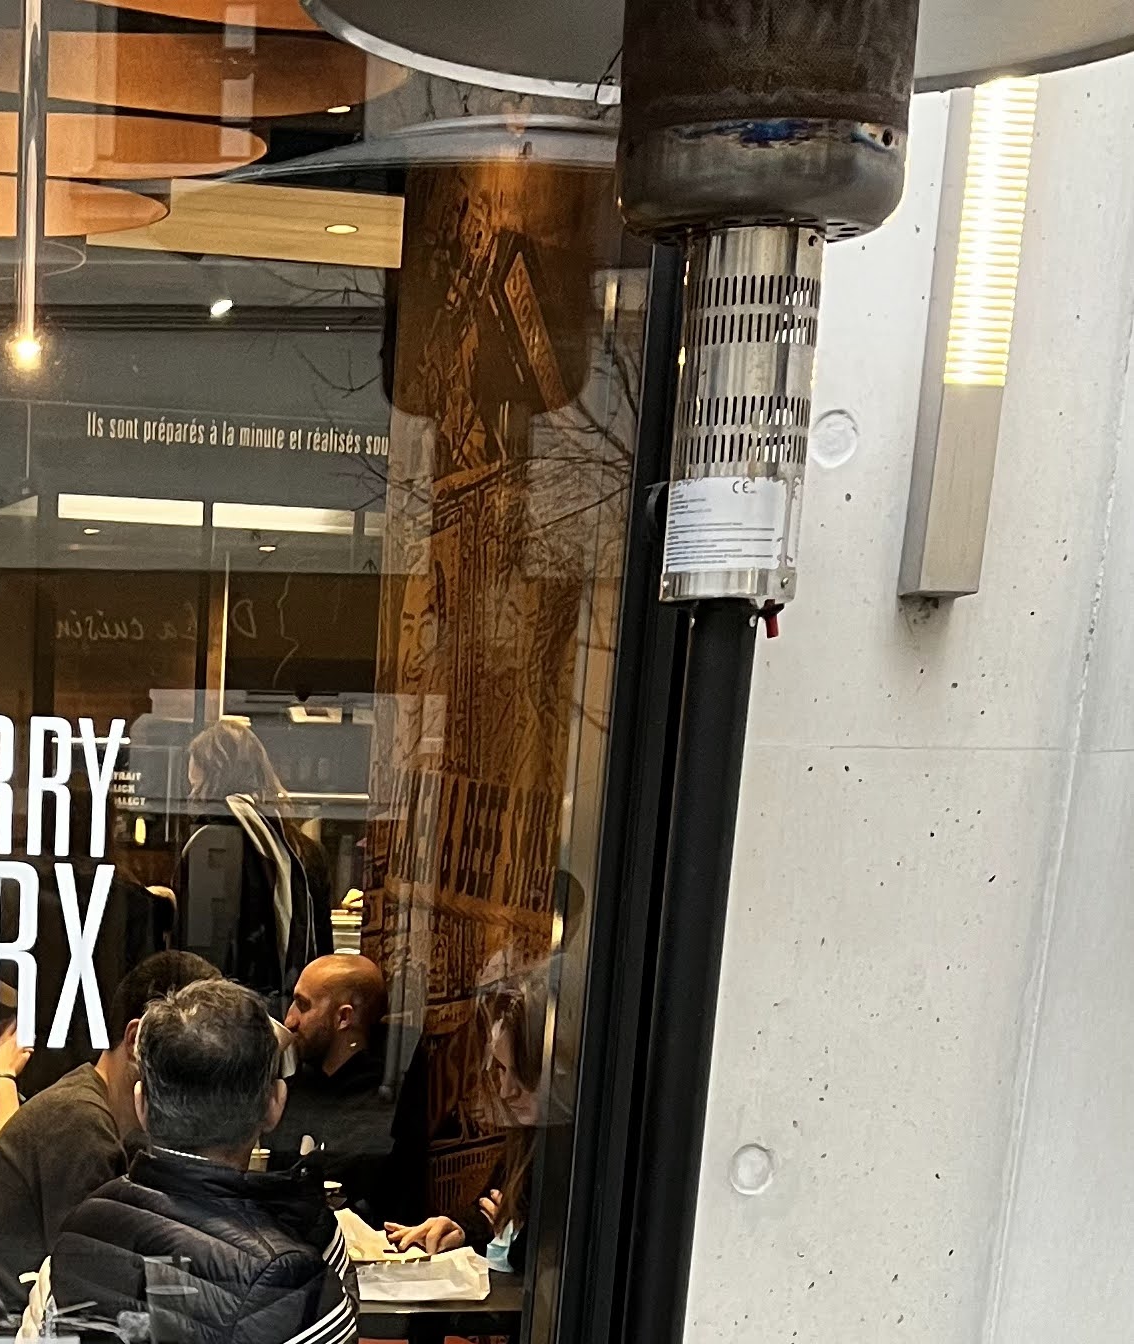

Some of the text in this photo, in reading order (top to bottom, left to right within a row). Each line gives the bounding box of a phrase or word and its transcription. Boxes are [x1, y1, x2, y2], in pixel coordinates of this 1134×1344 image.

[86, 410, 104, 438] Ils
[109, 417, 139, 440] sont
[143, 415, 205, 446] préparés
[209, 419, 219, 446] à
[222, 420, 236, 447] la
[239, 422, 285, 450] minute
[289, 429, 303, 451] et
[306, 426, 362, 454] réalisés
